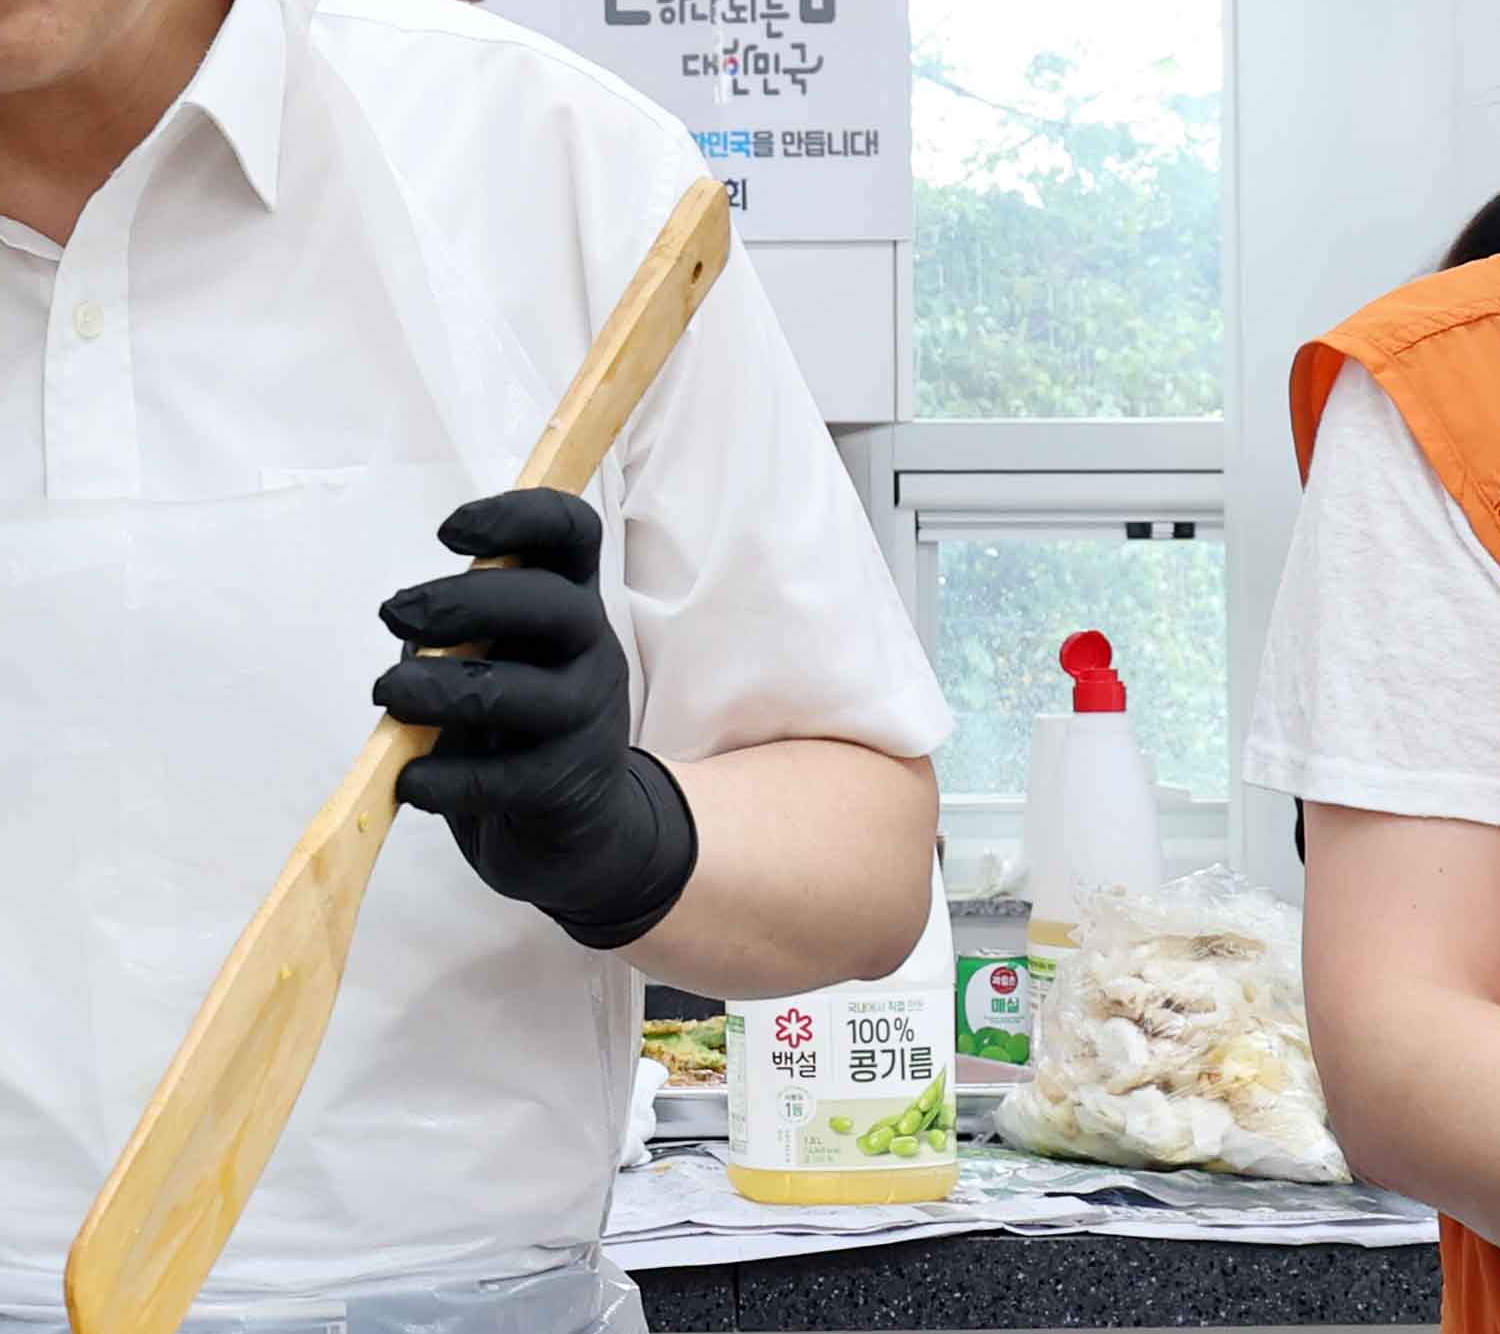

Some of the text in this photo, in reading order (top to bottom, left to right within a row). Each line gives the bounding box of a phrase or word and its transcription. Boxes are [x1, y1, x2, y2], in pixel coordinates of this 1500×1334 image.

[847, 1017, 915, 1044] 100%
[772, 1051, 816, 1078] 백설
[849, 1046, 933, 1082] 콩기름
